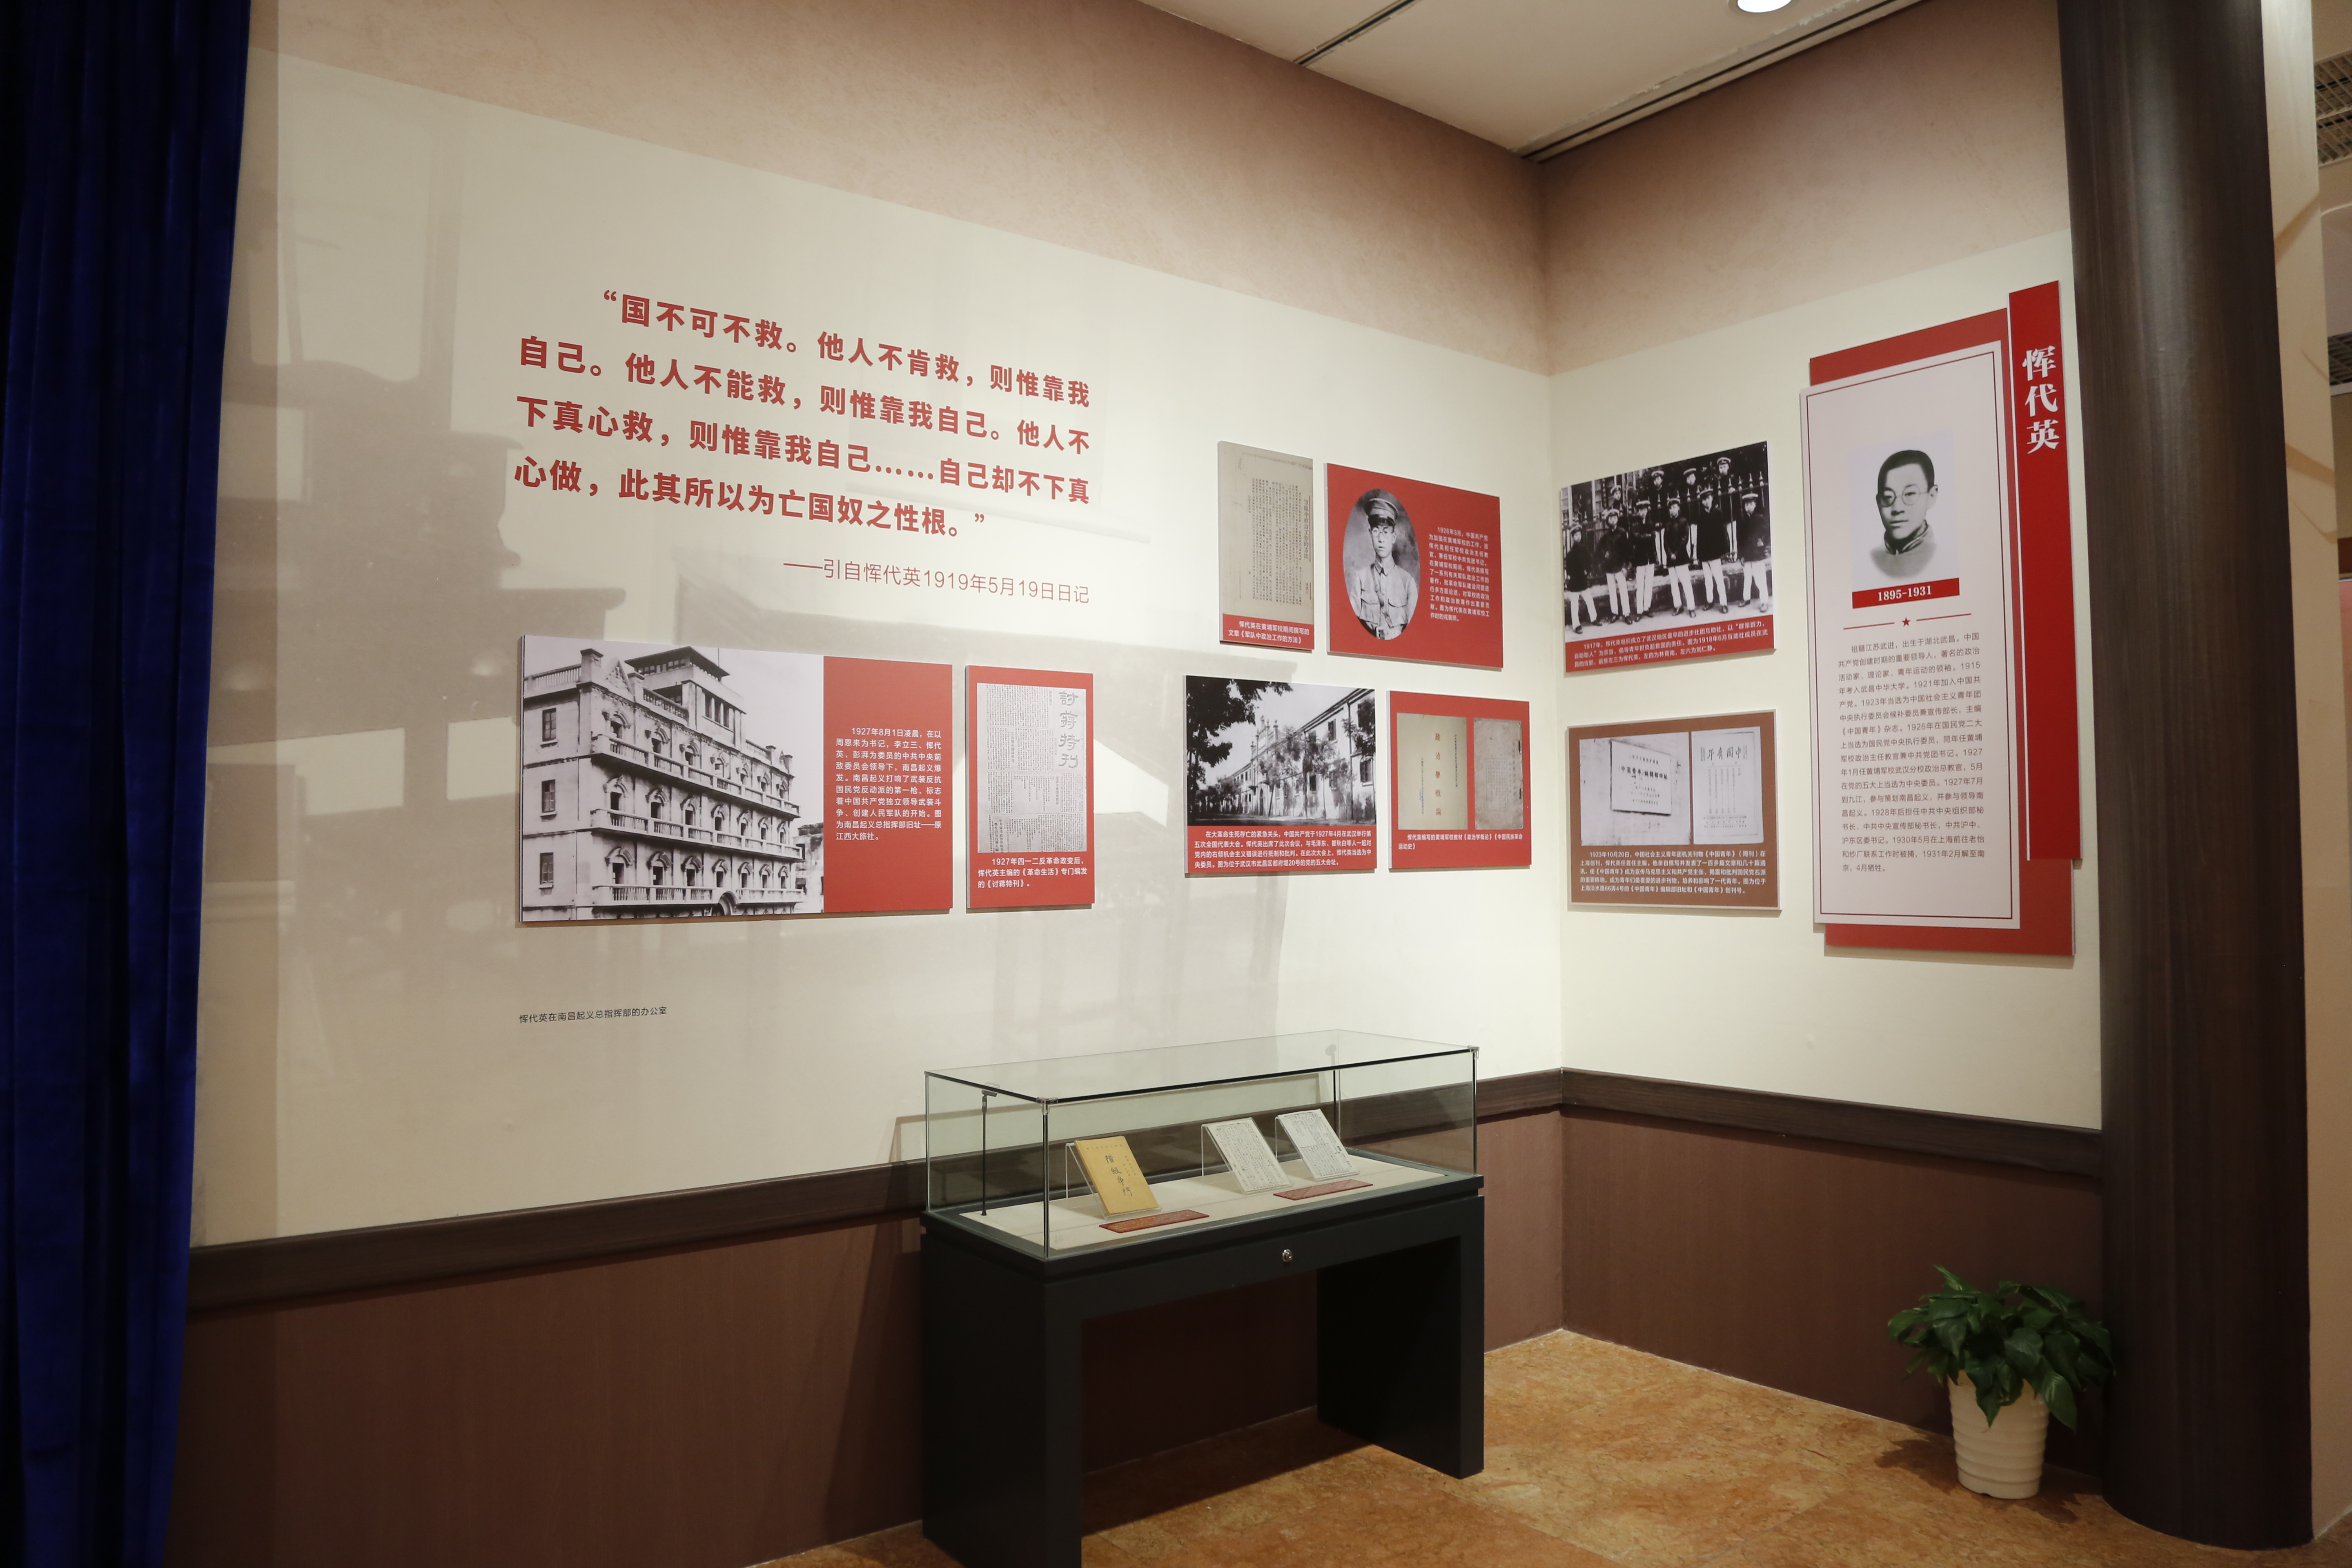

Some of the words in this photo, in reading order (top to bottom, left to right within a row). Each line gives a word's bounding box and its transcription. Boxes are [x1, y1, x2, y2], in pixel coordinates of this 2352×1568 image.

[604, 290, 1089, 407] “国不可不救。他人不肯救，则惟靠我
[521, 336, 1089, 454] 自己。他人不能救，则惟靠我自己。他人不
[2022, 345, 2060, 454] 恽代英
[514, 456, 984, 537] 心做，此其所以为亡国奴之性根。”
[1879, 586, 1931, 601] 1895-1931
[1239, 621, 1309, 635] 恽代英在黄埔军校期间撰写的
[1228, 630, 1301, 644] 文章《军队中政治工作的方法》
[852, 728, 941, 738] 1927年8月1日凌晨，在以
[836, 738, 941, 749] 周恩来为书记，李立三、恽代
[836, 750, 941, 761] 英、彭湃为委员的中共中央前
[836, 762, 941, 772] 敌委员会领导下，南昌起义爆
[836, 774, 941, 783] 发。南昌起义打响了武装反抗
[836, 786, 941, 794] 国民党反动派的第一枪，标志
[836, 797, 941, 806] 着中国共产党独立领导武装斗
[836, 809, 941, 817] 争、创建人民军队的开始。图
[978, 868, 1087, 877] 恽代英主编的《革命生活》专门编发
[978, 880, 1029, 888] 的《讨蒋特刊》。
[519, 1007, 666, 1023] 恽代英在南昌起义总指挥部的办公室
